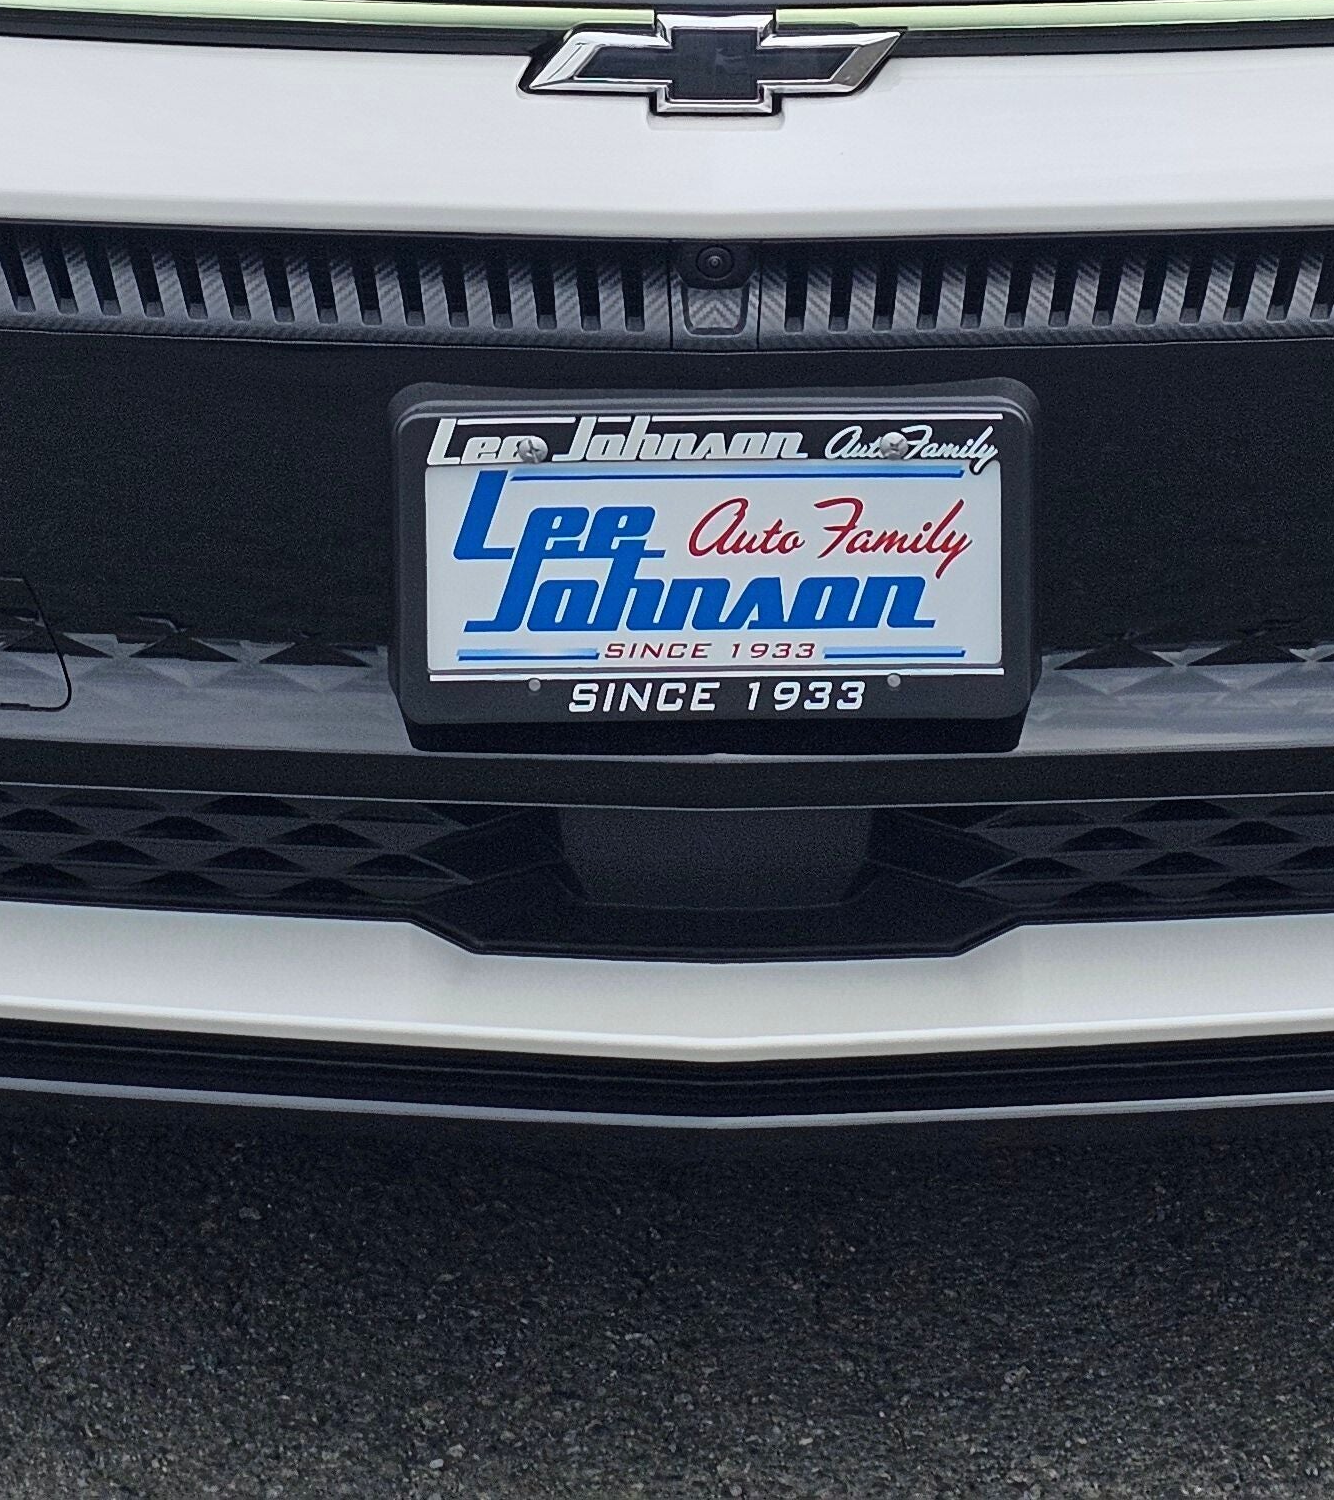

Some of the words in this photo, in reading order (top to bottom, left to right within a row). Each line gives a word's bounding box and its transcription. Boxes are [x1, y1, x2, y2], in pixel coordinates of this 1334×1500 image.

[552, 415, 809, 462] Johnson
[825, 425, 893, 460] Aut
[900, 424, 999, 473] Family
[453, 470, 666, 560] Lee
[688, 497, 805, 556] Auto
[813, 497, 973, 579] Family
[463, 545, 936, 633] Johnson
[604, 642, 712, 660] SINCE
[730, 642, 817, 660] 1933
[568, 681, 721, 713] SINCE
[746, 680, 866, 711] 1933
